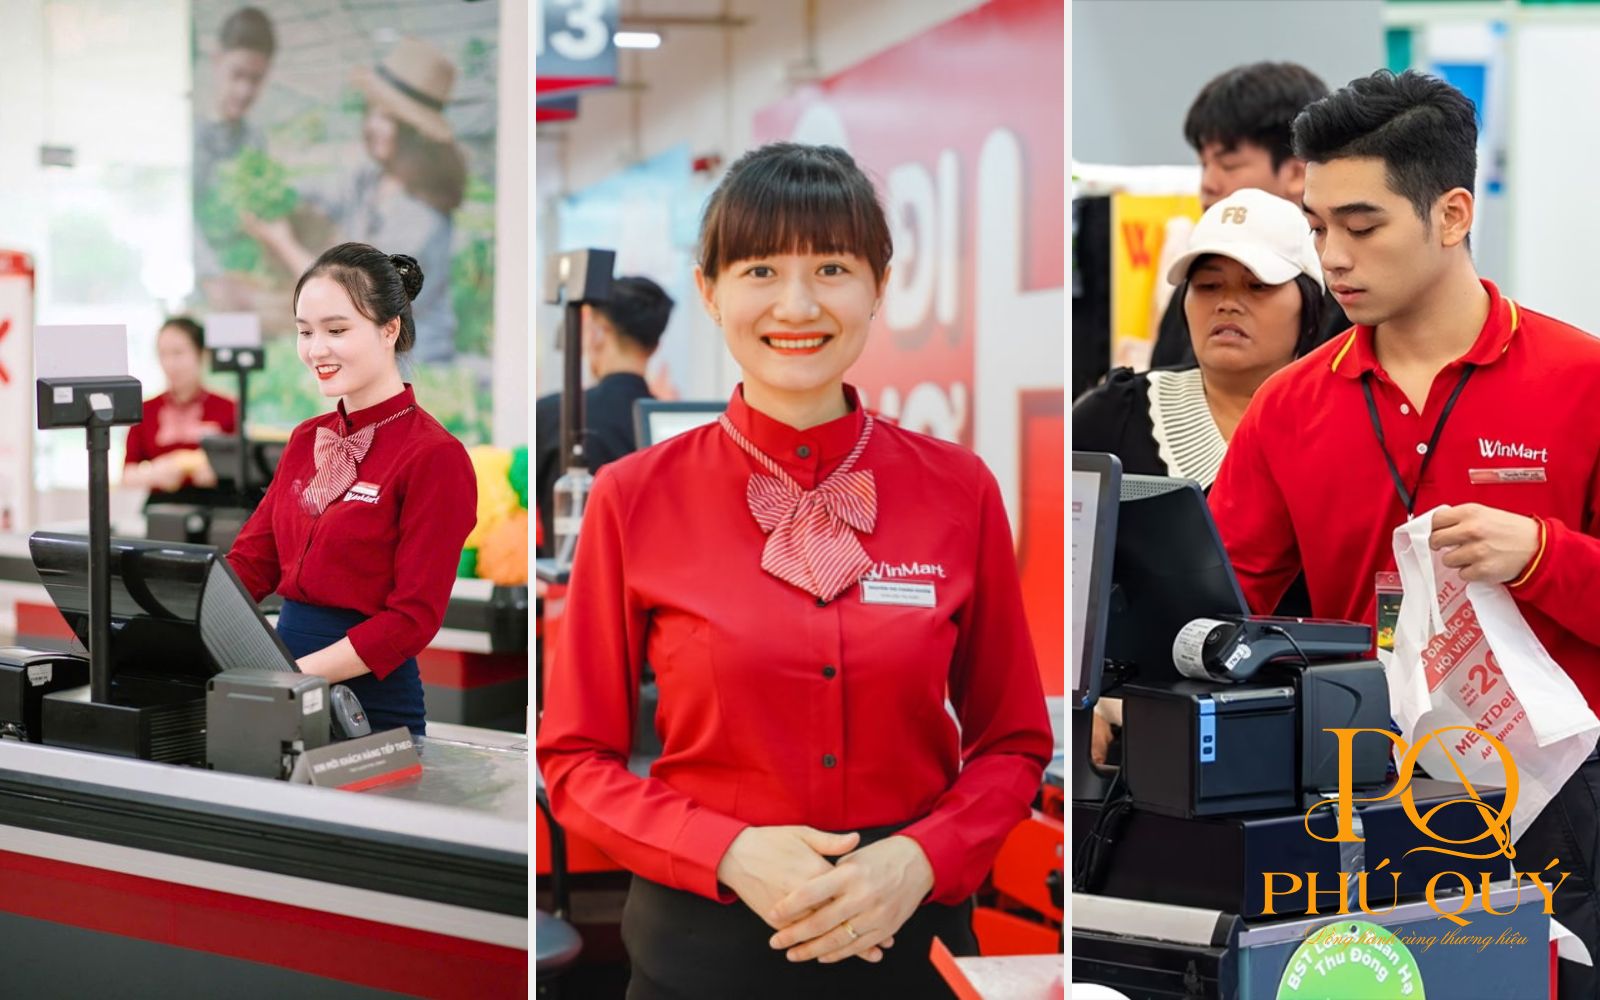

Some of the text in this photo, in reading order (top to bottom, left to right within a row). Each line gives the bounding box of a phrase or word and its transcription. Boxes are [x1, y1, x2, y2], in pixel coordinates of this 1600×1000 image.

[1478, 437, 1548, 463] WinMart
[1287, 949, 1314, 991] BST
[1314, 948, 1390, 983] Thu Đông
